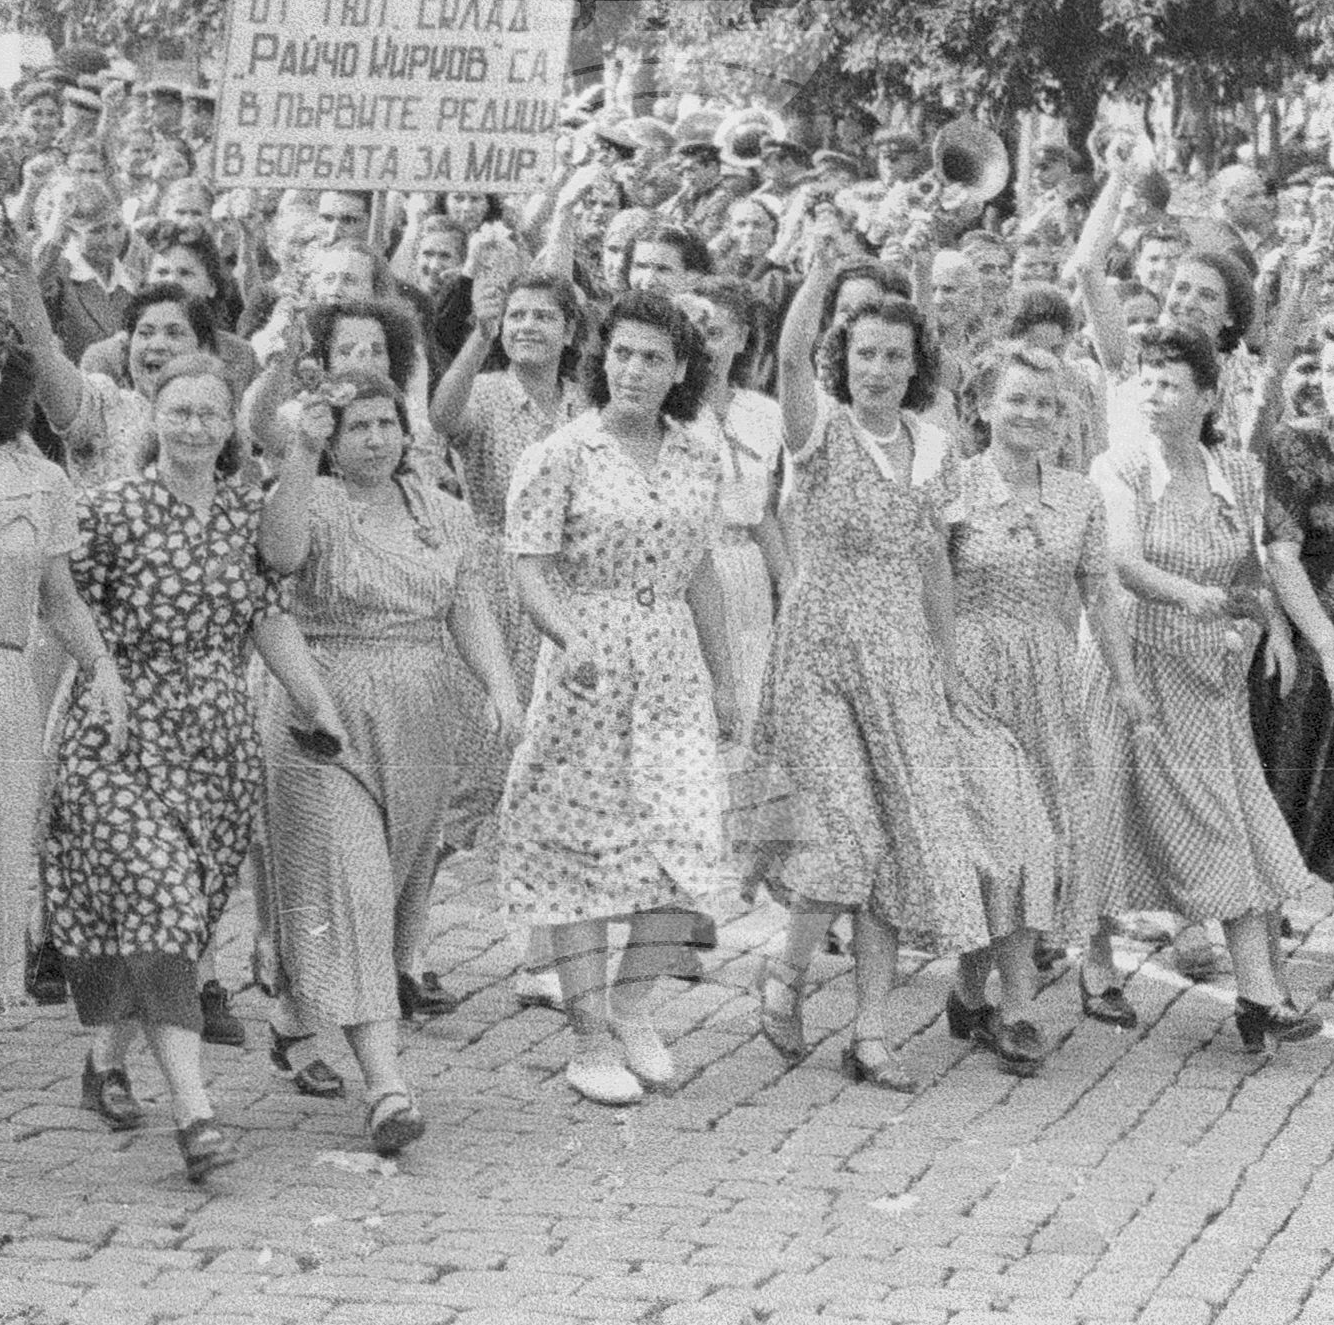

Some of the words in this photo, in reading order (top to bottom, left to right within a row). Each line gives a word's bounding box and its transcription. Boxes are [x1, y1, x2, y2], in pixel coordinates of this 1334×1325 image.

[509, 48, 548, 84] СА
[238, 91, 261, 128] В
[272, 92, 423, 130] ПЪРВИТЕ
[436, 96, 560, 135] РЕДИЦИ
[222, 141, 245, 177] В
[255, 142, 399, 179] БОРБАТА
[414, 144, 452, 181] ЗА
